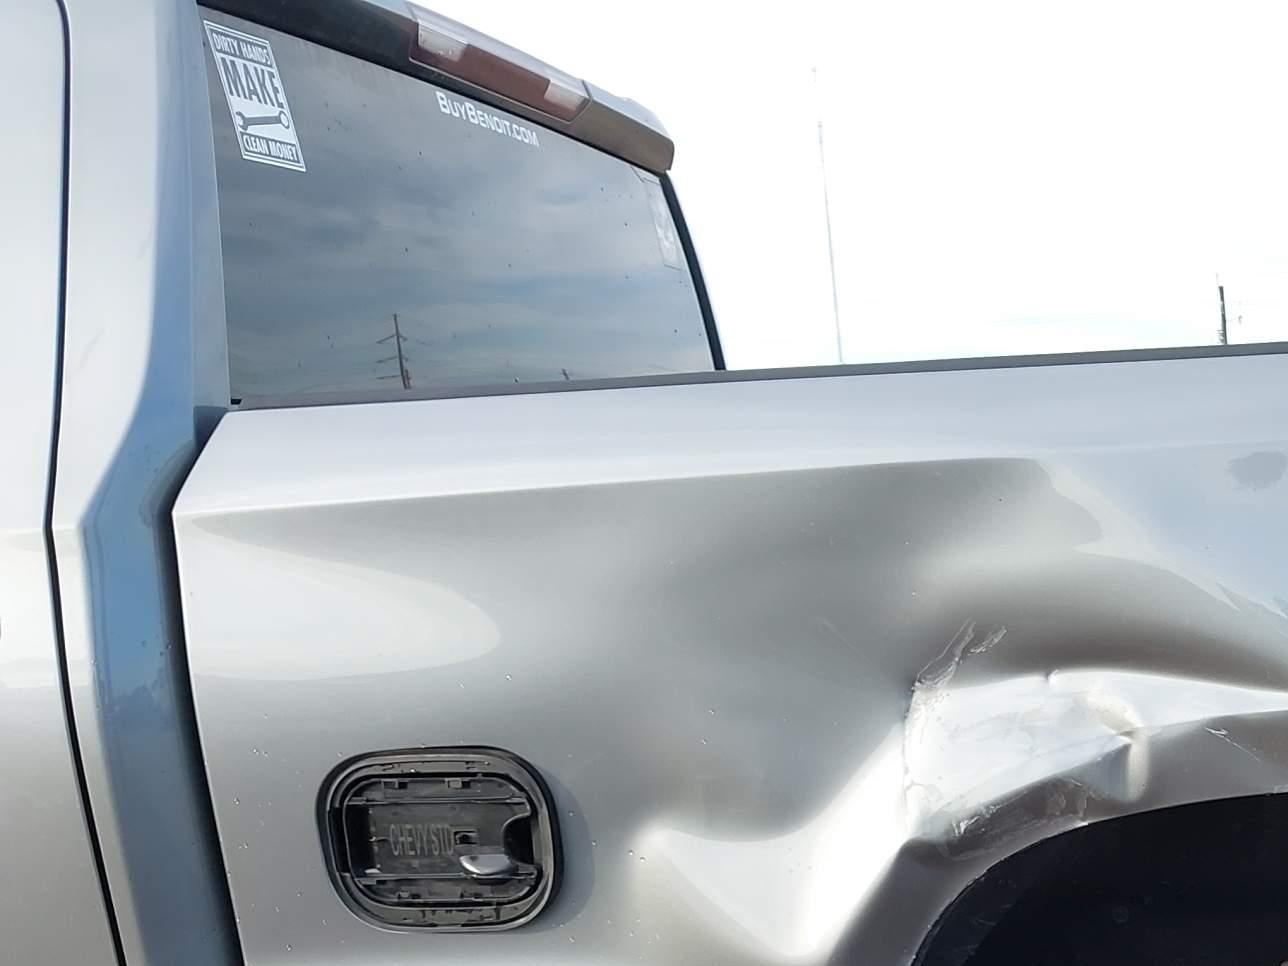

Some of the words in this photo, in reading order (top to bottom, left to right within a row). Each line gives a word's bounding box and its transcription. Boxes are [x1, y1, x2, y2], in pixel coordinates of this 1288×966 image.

[212, 32, 241, 56] DIRTY
[240, 42, 271, 65] HANDS
[220, 56, 285, 109] MAKE
[243, 135, 268, 156] CLEAN
[267, 140, 298, 162] MONEY
[388, 823, 429, 856] CHEVY
